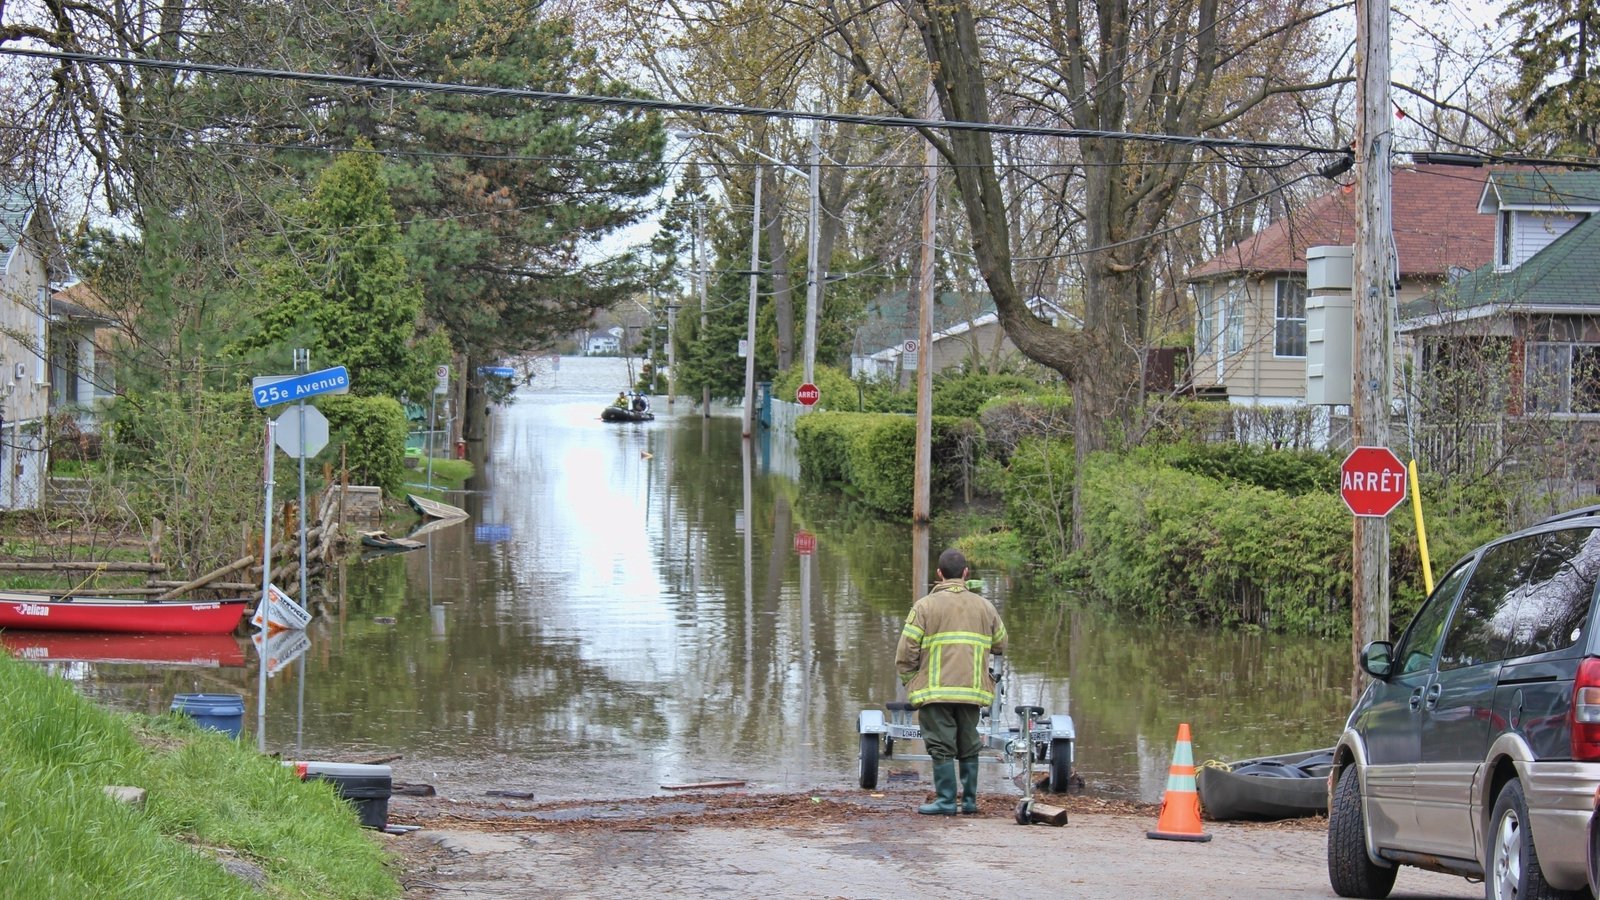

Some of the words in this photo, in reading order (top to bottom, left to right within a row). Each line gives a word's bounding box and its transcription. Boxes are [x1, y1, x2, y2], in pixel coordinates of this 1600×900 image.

[258, 387, 289, 403] 25e
[296, 376, 344, 395] Avenue
[798, 390, 818, 398] ARRÊT
[1343, 468, 1403, 493] ARRÊT
[21, 604, 49, 616] Pelican
